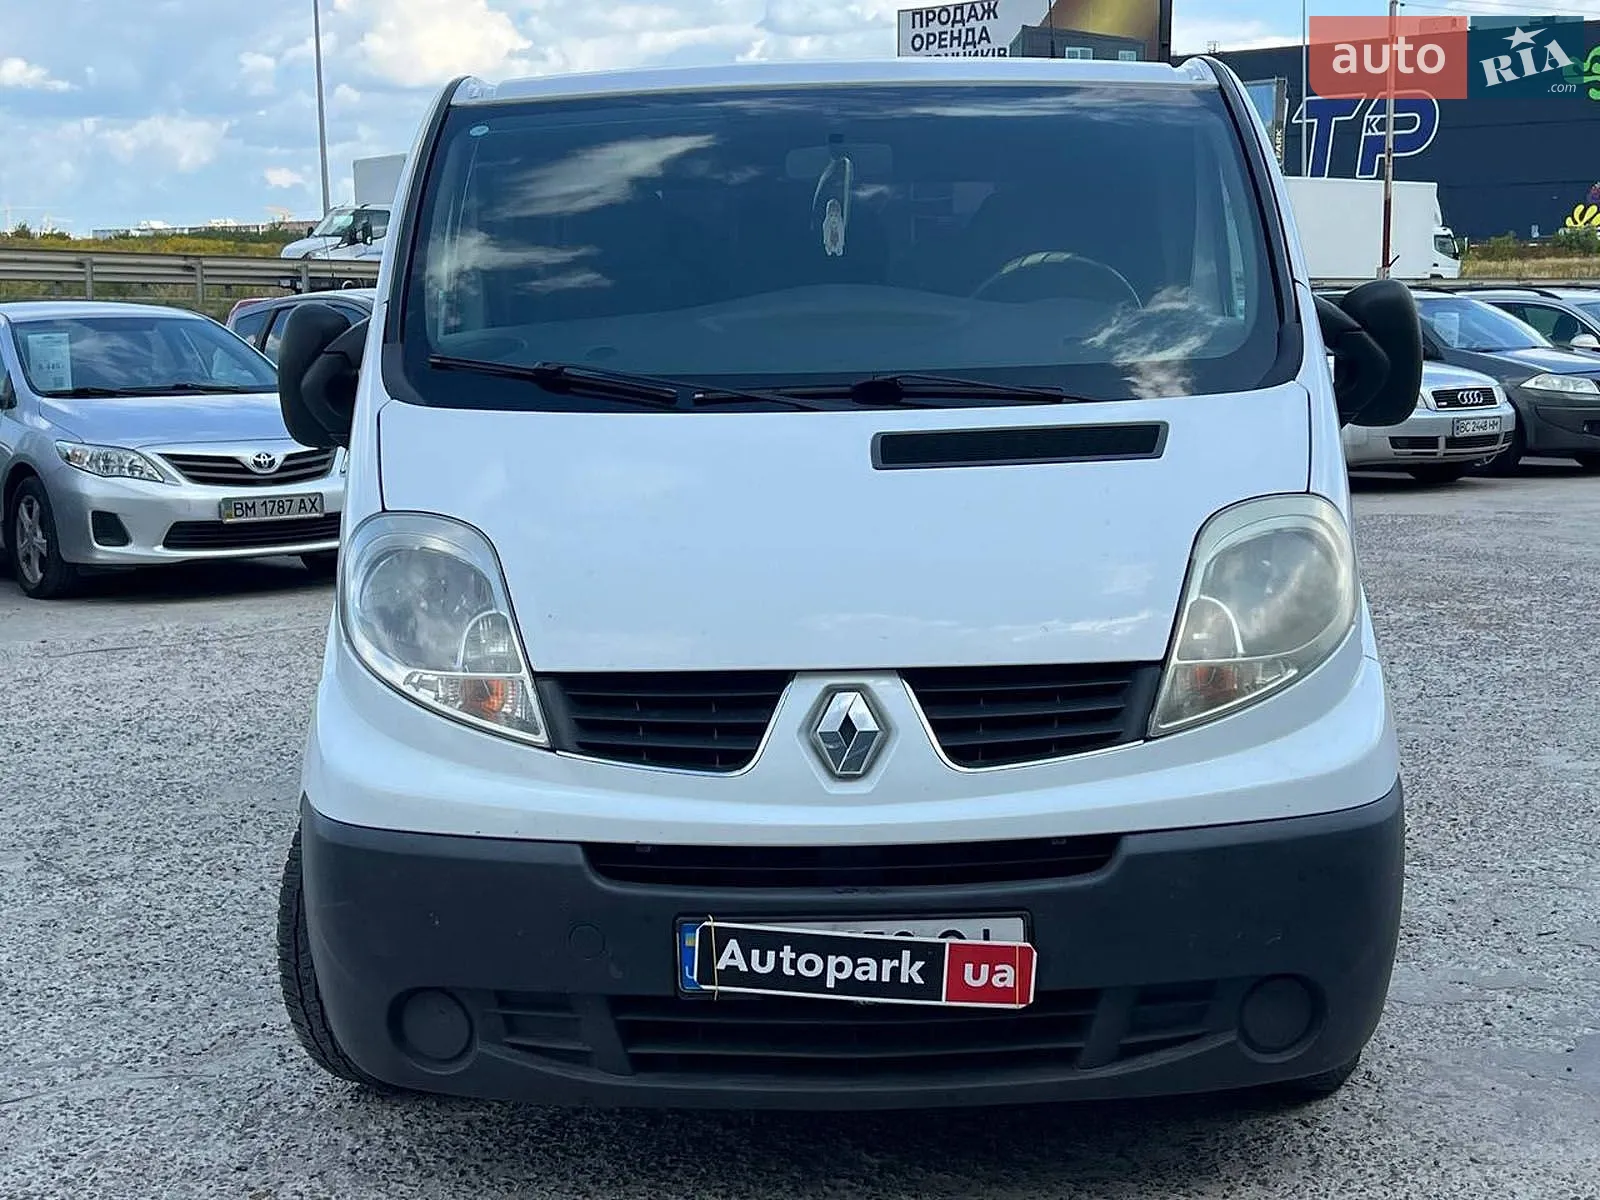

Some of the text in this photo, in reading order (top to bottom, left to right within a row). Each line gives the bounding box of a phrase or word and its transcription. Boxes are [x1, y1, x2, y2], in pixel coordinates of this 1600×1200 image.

[911, 1, 998, 29] ПРОДАЖ
[911, 26, 991, 52] ОРЕНДА
[233, 497, 319, 517] BM 1787 AX
[716, 938, 1016, 989] Autopark ua
